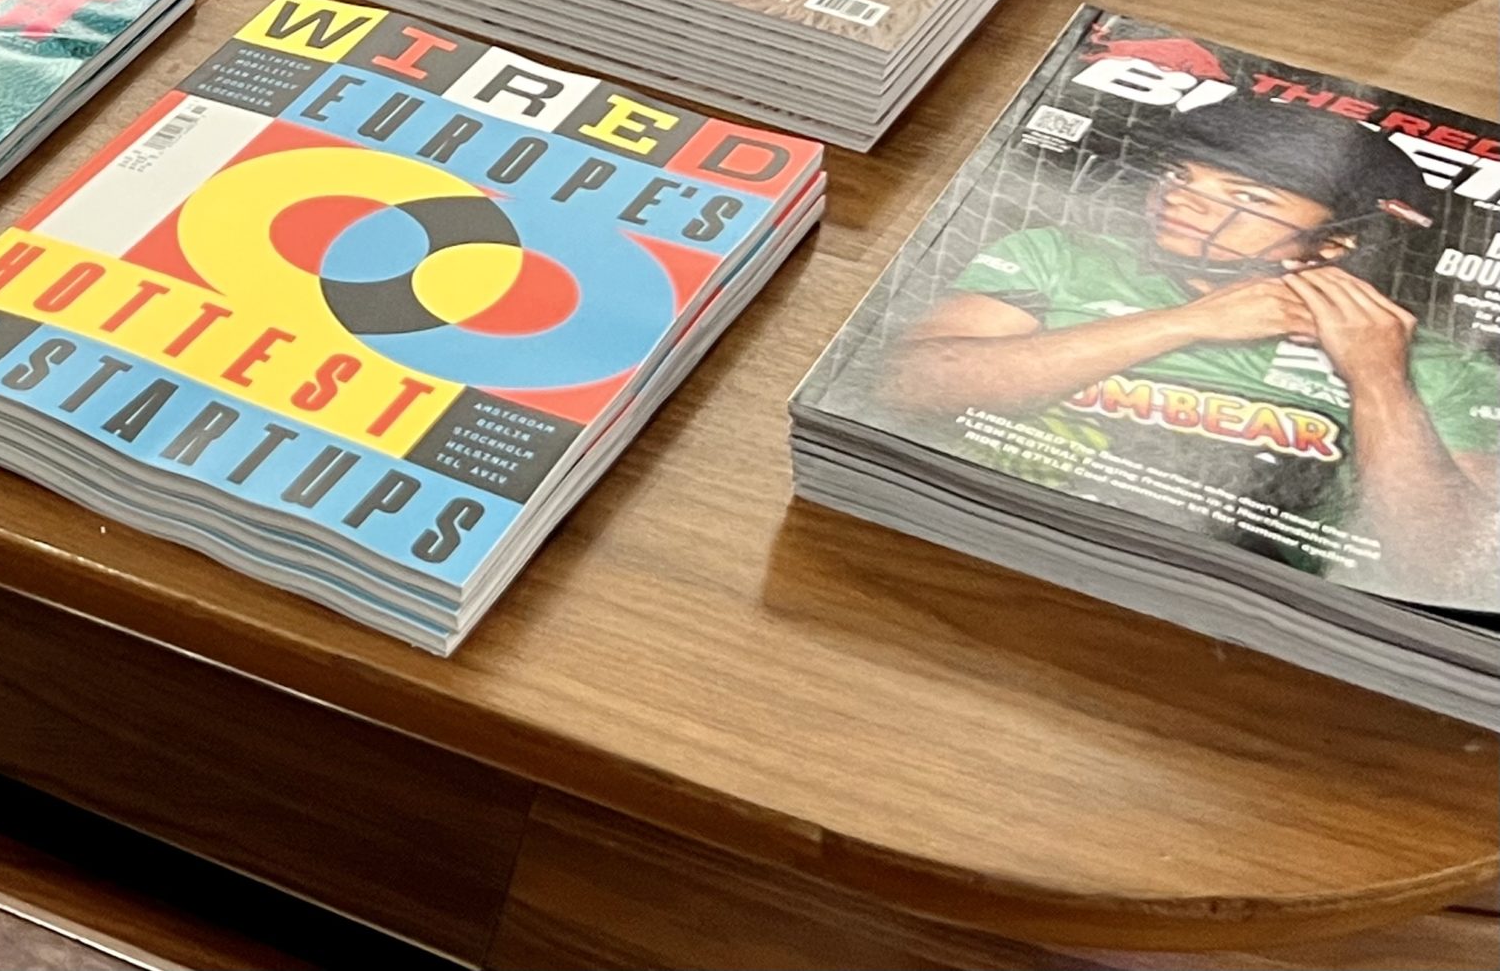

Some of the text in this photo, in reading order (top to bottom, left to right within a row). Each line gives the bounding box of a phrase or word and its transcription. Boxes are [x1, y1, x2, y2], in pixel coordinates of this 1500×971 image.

[263, 1, 790, 183] WIRED
[1252, 73, 1382, 121] THE
[301, 76, 745, 243] EUROPE'S
[473, 402, 555, 433] AMSTERDAM
[476, 418, 530, 441] BERLIN
[1, 338, 485, 564] STARTUPS
[445, 440, 517, 470] HELSINKI
[452, 426, 534, 459] STOCKHOLM
[963, 430, 1001, 449] RIDE
[1001, 442, 1021, 455] IN
[1019, 448, 1073, 472] STYLE
[1005, 431, 1081, 462] FESTIVAL
[435, 453, 507, 483] TEL AVIV
[1278, 510, 1321, 530] need
